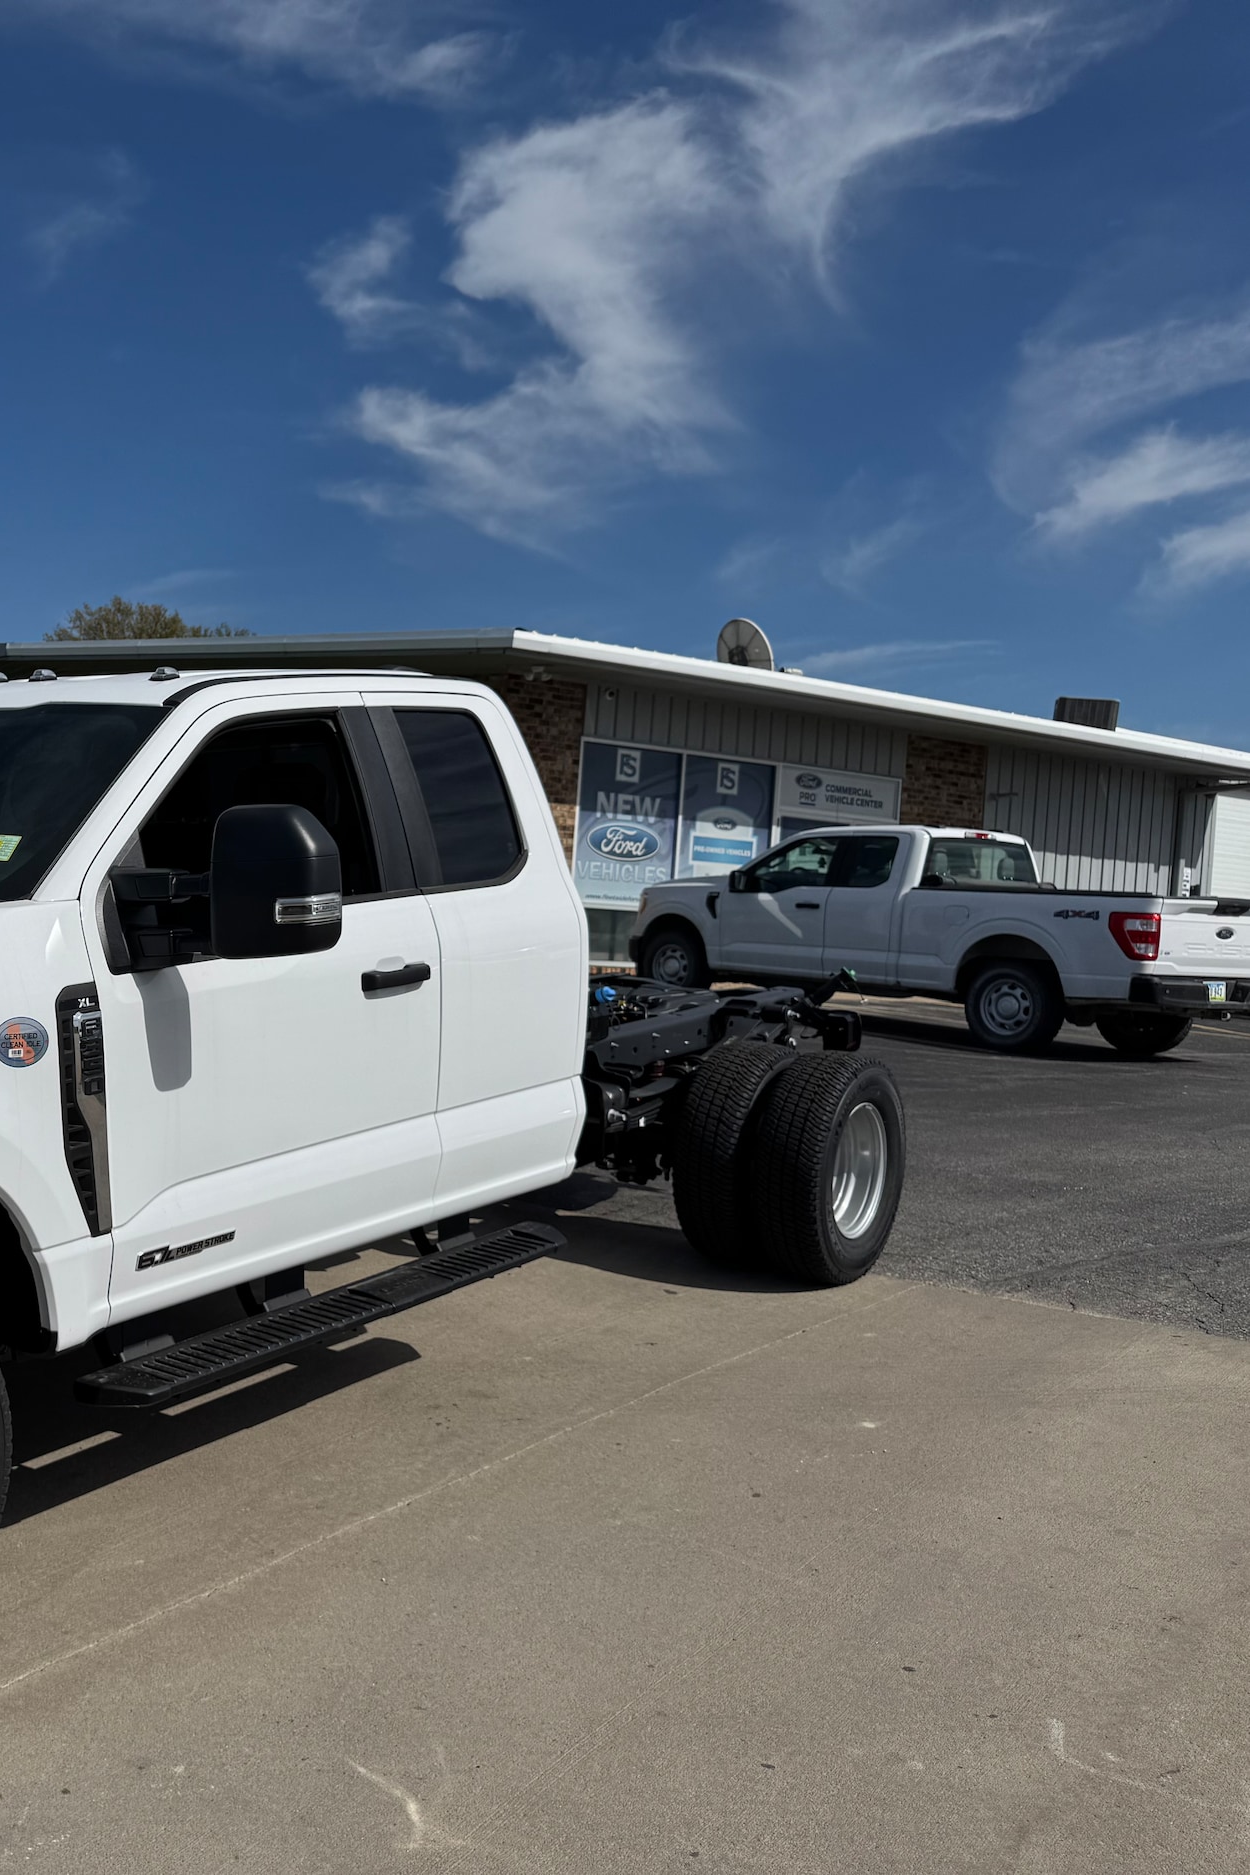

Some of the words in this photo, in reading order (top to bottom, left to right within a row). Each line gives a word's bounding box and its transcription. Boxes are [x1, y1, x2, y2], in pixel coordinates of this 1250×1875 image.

[799, 791, 816, 802] PRO
[825, 784, 873, 798] COMMERCIAL
[596, 791, 662, 824] NEW
[825, 794, 855, 806] VEHICLE
[855, 798, 883, 809] CENTER
[600, 826, 648, 856] Ford
[726, 848, 751, 857] VEHICLES
[577, 860, 667, 883] VEHICLES
[78, 997, 96, 1008] XL
[4, 1032, 38, 1040] CERTIFIED
[1, 1041, 24, 1049] CLEAN
[137, 1244, 174, 1269] 6.7L
[175, 1240, 204, 1256] POWER
[204, 1231, 235, 1248] STROKE
